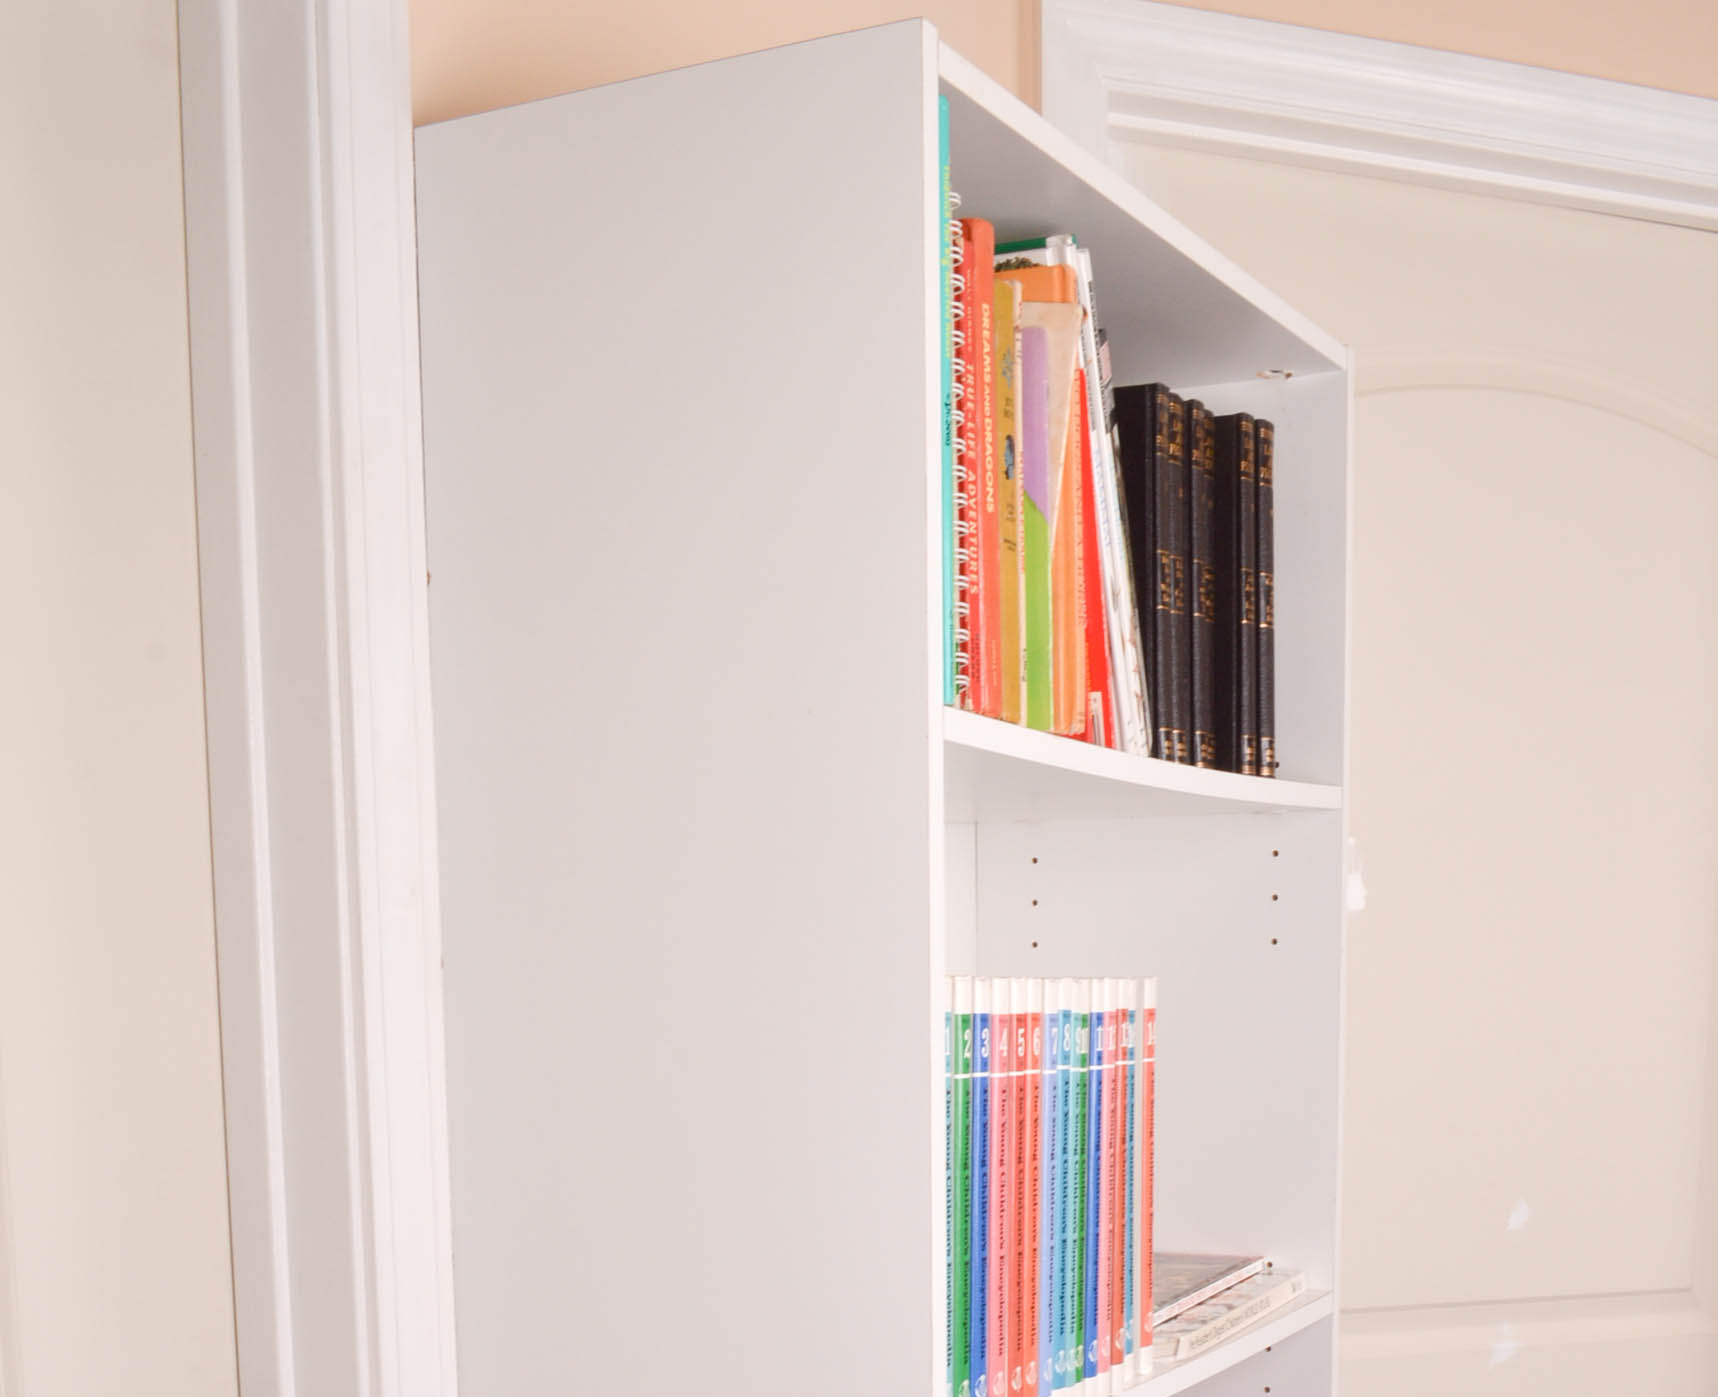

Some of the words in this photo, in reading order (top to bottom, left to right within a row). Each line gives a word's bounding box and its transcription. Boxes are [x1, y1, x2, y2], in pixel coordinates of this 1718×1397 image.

[981, 303, 992, 383] DREAMS
[965, 363, 976, 460] TRUE-LIFE
[983, 384, 992, 416] AND
[983, 417, 995, 514] DRAGONS
[965, 469, 979, 595] ADVENTURES
[963, 1028, 972, 1059] 2
[981, 1027, 990, 1058] 3
[999, 1027, 1008, 1057] 4
[1017, 1027, 1025, 1057] 5
[1032, 1027, 1041, 1056] 6
[1051, 1027, 1059, 1056] 7
[1063, 1023, 1072, 1052] 8
